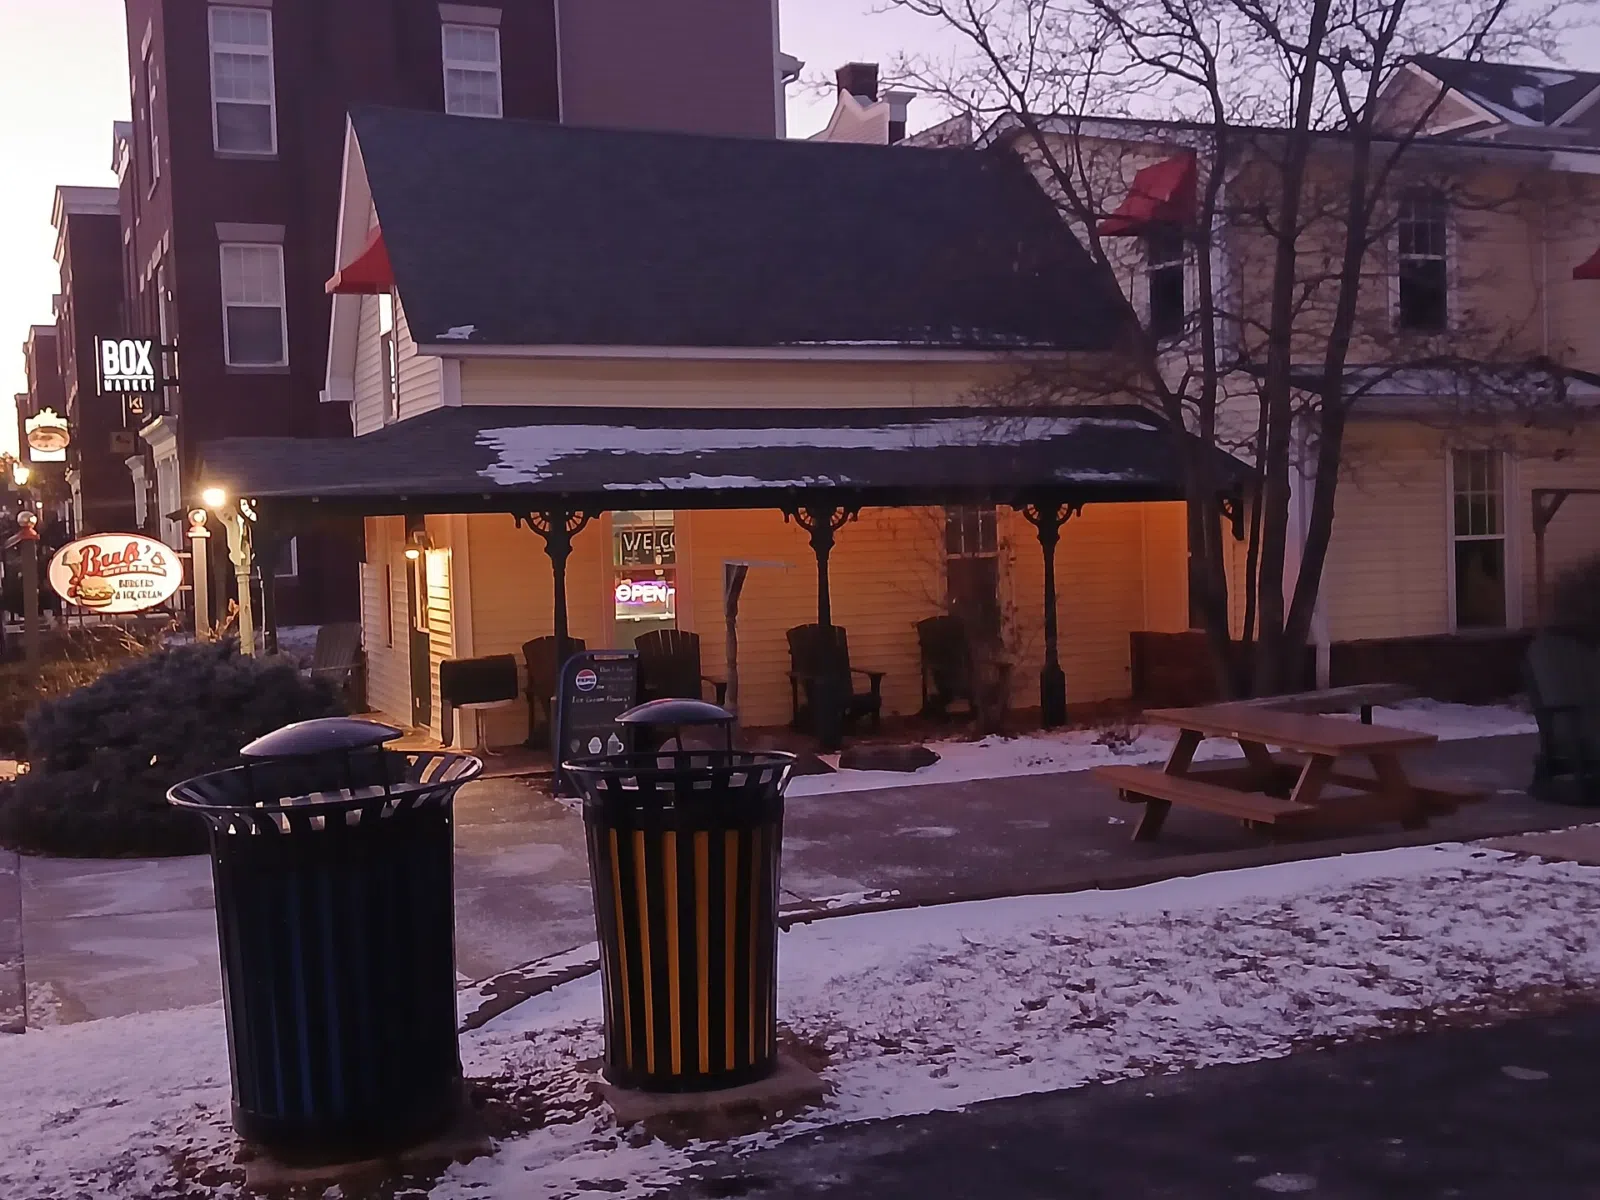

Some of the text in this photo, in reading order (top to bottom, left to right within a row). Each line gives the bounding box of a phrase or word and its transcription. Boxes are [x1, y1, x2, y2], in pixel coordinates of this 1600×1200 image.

[102, 340, 154, 375] BOX
[104, 379, 154, 391] MARKET
[119, 579, 154, 588] BURGERS
[616, 584, 667, 603] OPEN
